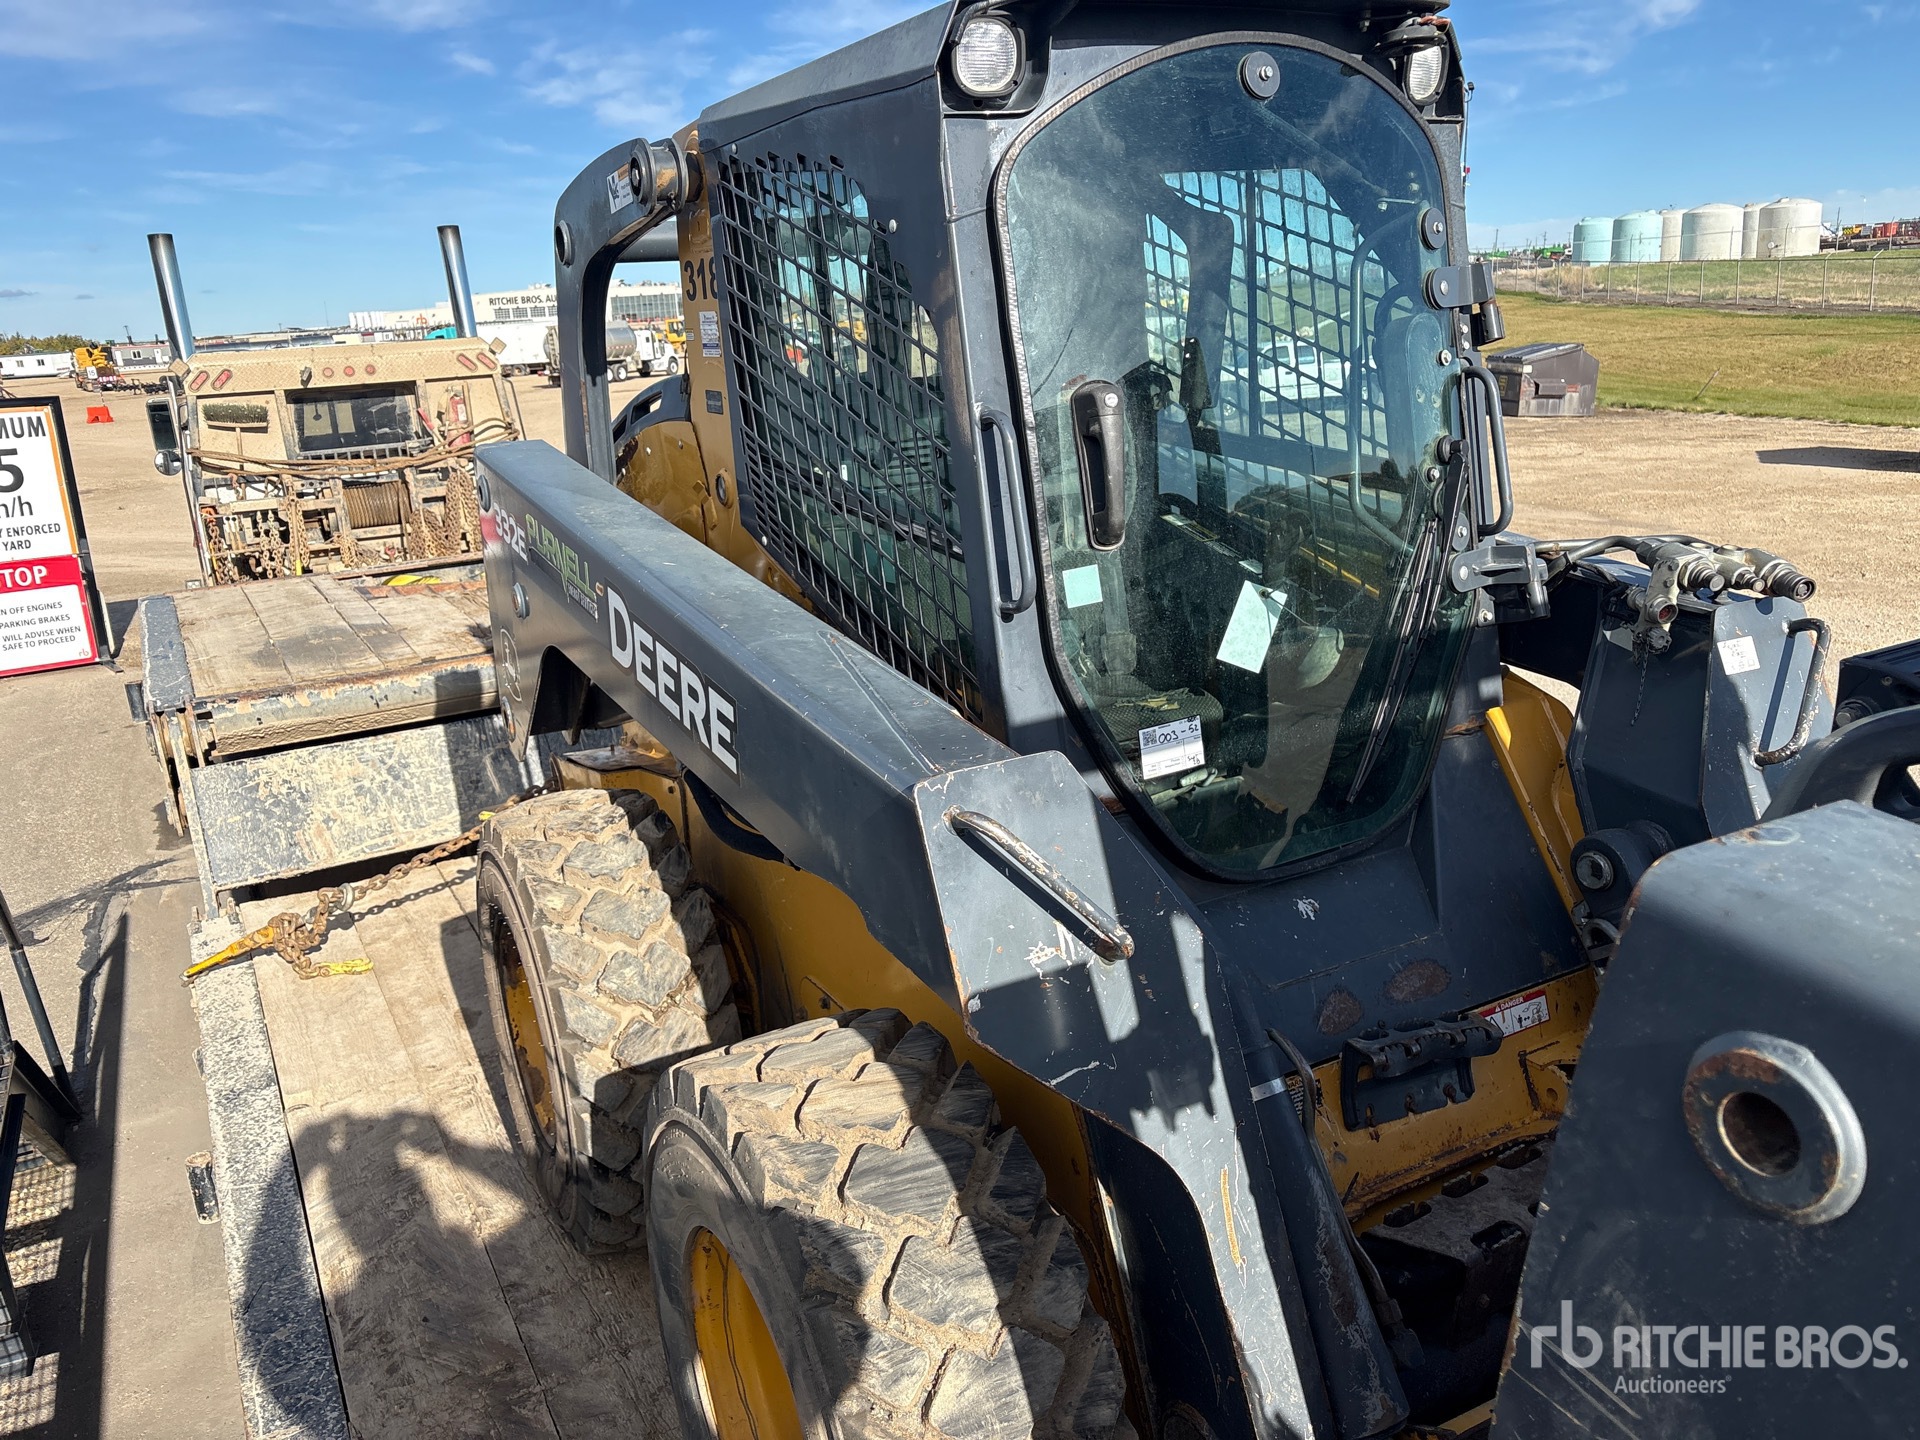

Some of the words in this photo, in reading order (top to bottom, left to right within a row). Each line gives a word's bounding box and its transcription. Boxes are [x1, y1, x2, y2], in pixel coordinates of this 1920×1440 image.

[489, 297, 519, 306] RITCHIE
[521, 295, 544, 304] BROS.
[6, 523, 61, 538] ENFORCED
[494, 502, 528, 562] 332E
[2, 540, 31, 551] YARD
[0, 565, 47, 588] TOP
[9, 607, 24, 615] OFF
[27, 601, 63, 612] ENGINES
[0, 618, 37, 629] PARKING
[38, 614, 71, 624] BRAKES
[2, 634, 23, 642] WILL
[25, 629, 54, 639] ADVISE
[56, 626, 81, 635] WHEN
[2, 642, 23, 651] SAFE
[38, 635, 76, 646] PROCEED
[607, 586, 738, 775] DEERE
[1500, 997, 1524, 1009] DANGER
